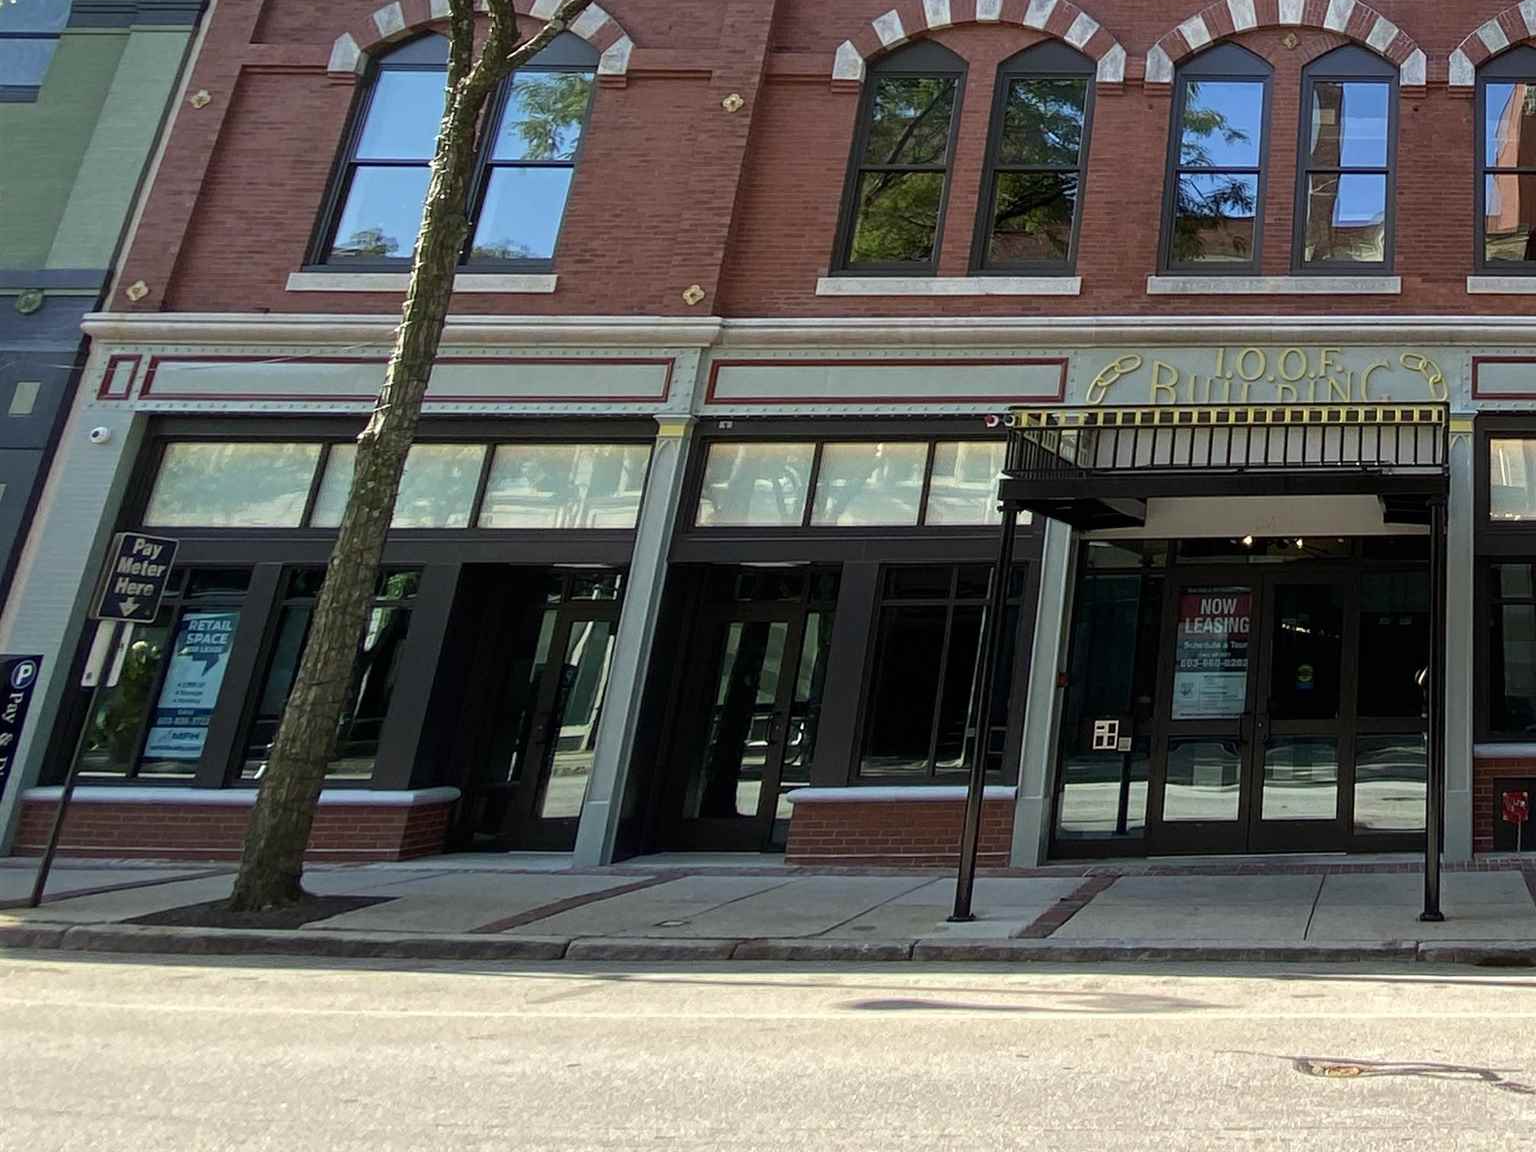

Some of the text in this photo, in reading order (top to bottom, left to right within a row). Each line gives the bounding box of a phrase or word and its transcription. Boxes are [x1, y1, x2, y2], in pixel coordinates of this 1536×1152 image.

[1215, 347, 1346, 382] I.O.O.F.
[133, 538, 163, 560] Pay
[117, 556, 167, 577] Meter
[114, 577, 154, 596] Here
[1200, 598, 1237, 614] NOW
[188, 620, 232, 631] RETAIL
[1184, 617, 1249, 633] LEASING
[186, 633, 229, 644] SPACE
[2, 692, 24, 723] Pay
